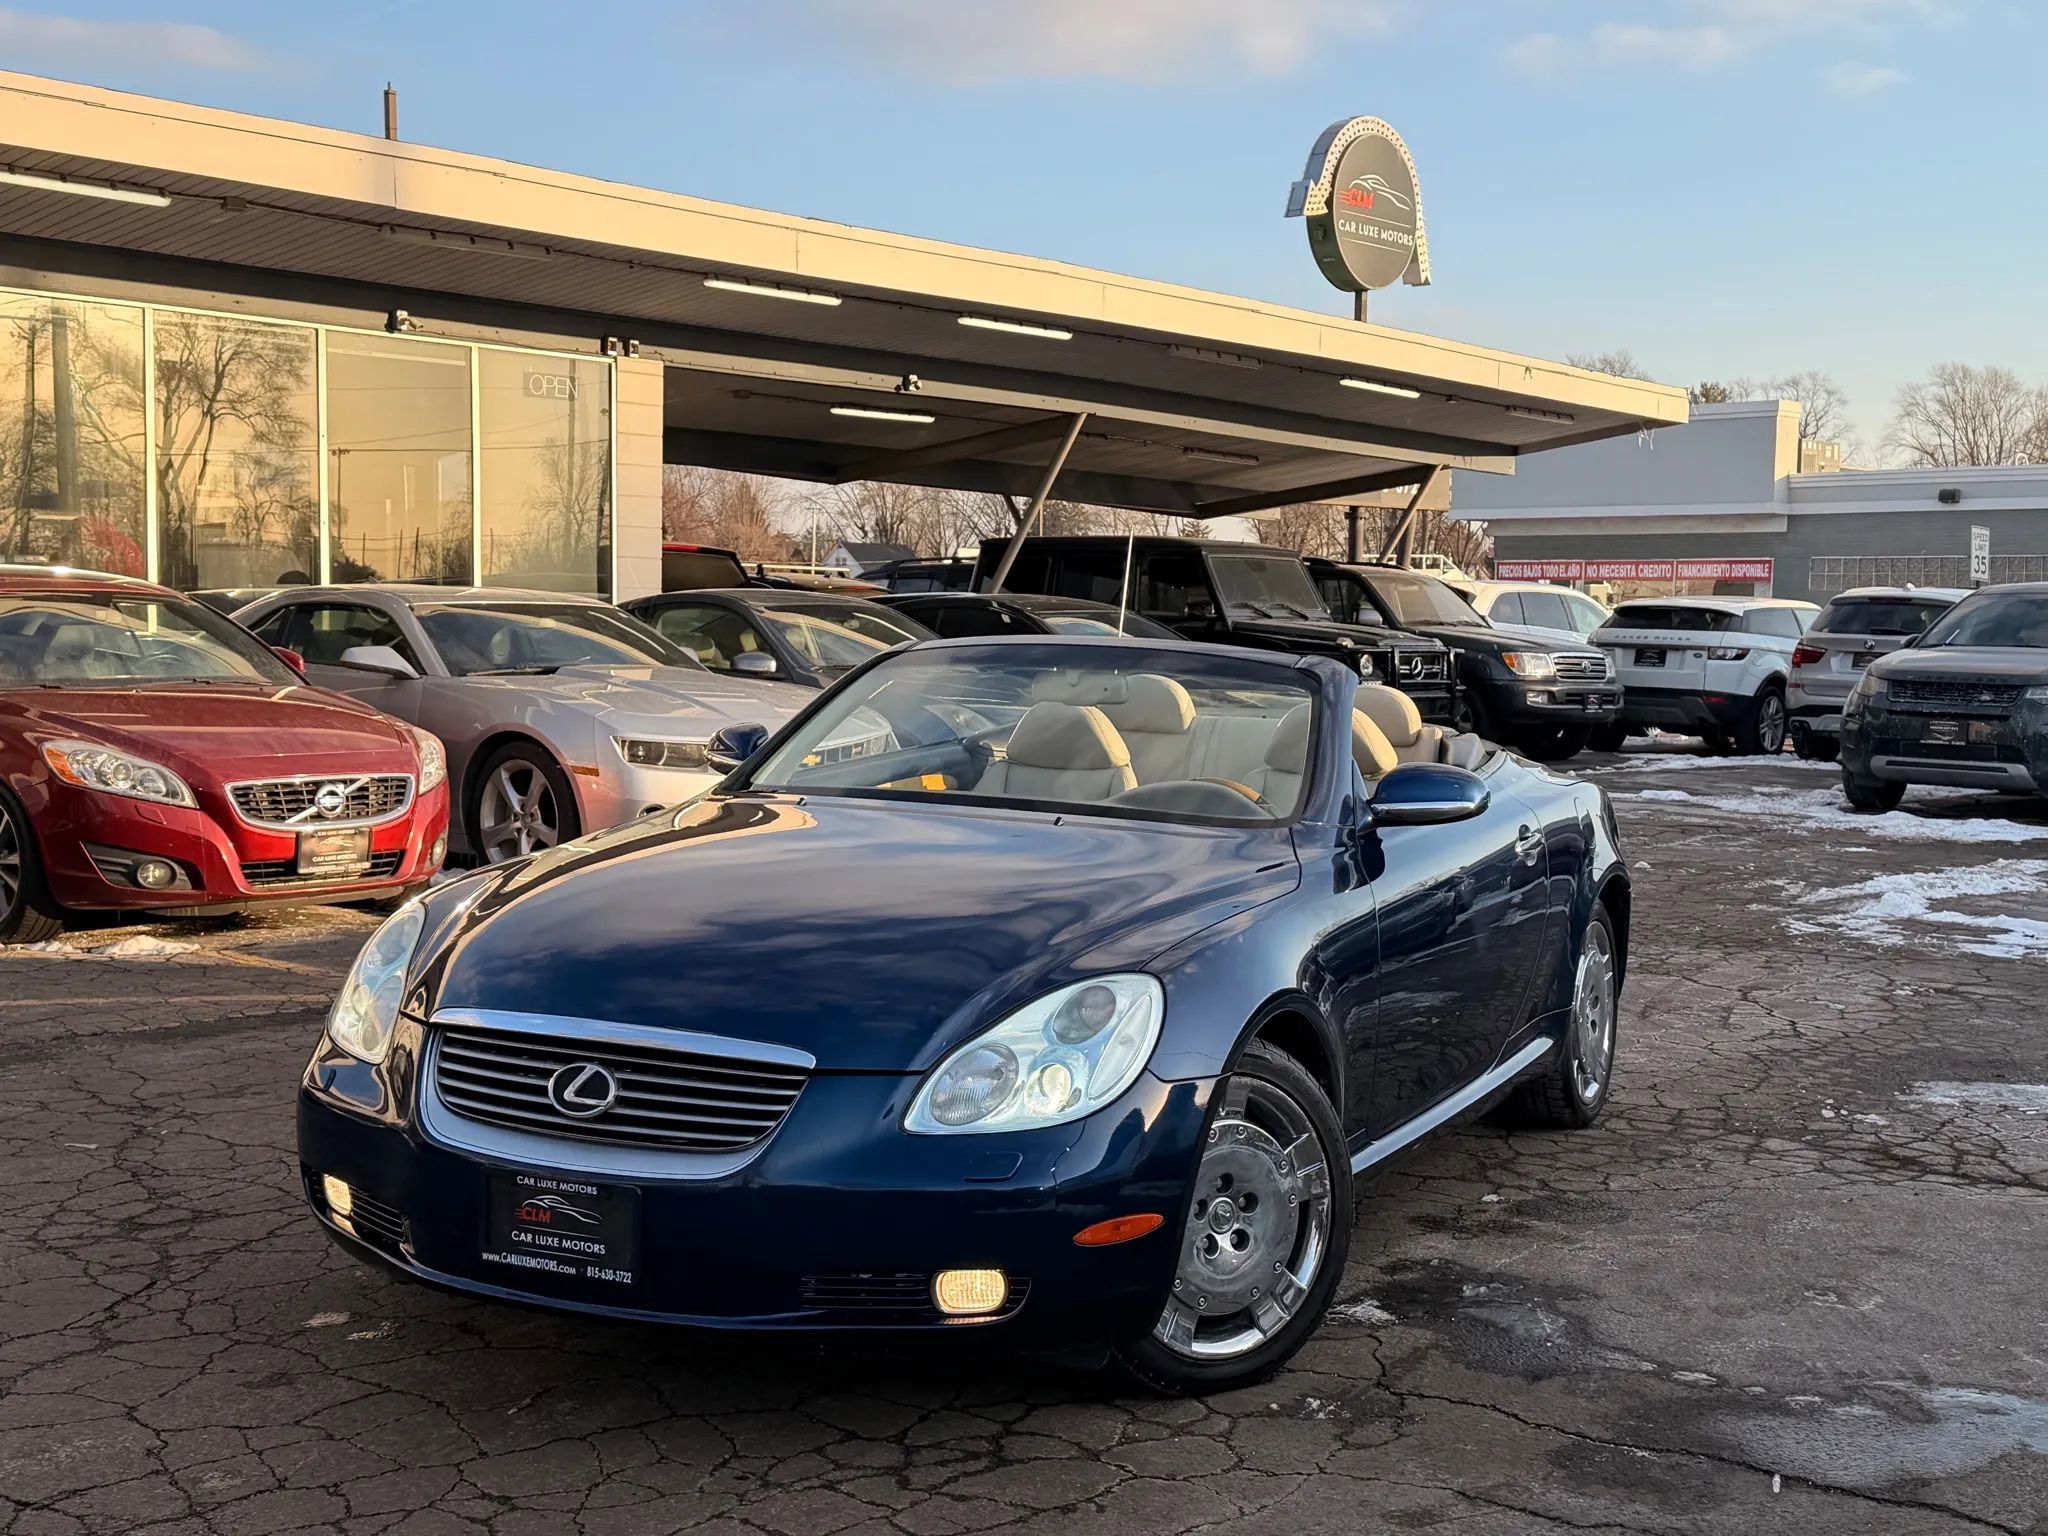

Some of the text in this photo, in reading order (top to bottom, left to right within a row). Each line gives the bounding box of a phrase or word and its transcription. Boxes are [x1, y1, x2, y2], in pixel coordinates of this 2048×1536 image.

[1349, 188, 1375, 209] CLM
[1338, 219, 1413, 246] CAR LUXE MOTORS
[529, 374, 578, 399] OPEN
[1974, 531, 1988, 542] SPEED
[1974, 542, 1987, 553] LIMIT
[1498, 563, 1579, 578] PRECIOS BAJOS TODO EL AÑO
[1586, 564, 1672, 578] NO NECESITA CREDITO
[1678, 563, 1769, 577] FINANCIAMIENTO DISPONIBLE
[1974, 555, 1987, 575] 35
[516, 1176, 598, 1195] CAR LUXE MOTORS
[522, 1207, 551, 1223] CLM
[511, 1230, 606, 1255] CAR LUXE MOTORS
[587, 1265, 632, 1283] 815-630-3722
